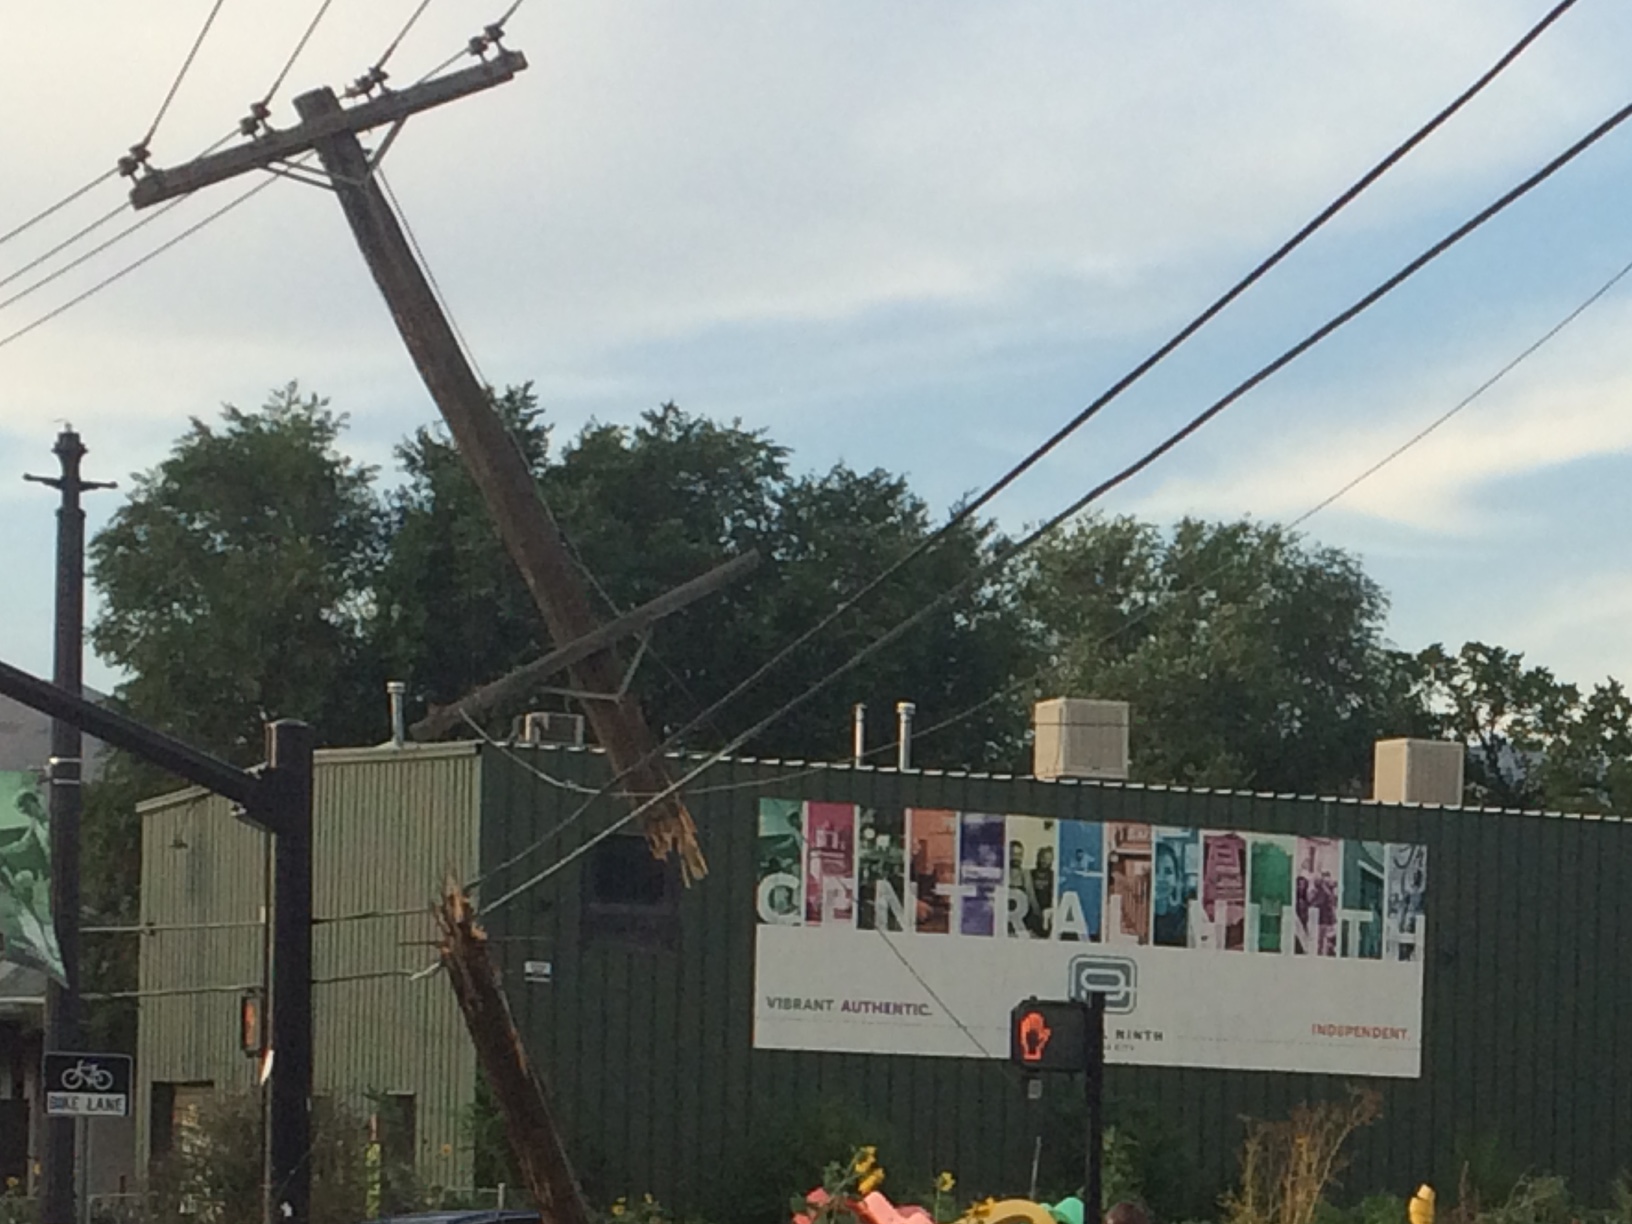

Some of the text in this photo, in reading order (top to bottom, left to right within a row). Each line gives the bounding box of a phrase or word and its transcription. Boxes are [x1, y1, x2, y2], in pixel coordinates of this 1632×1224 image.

[757, 872, 1426, 963] CENTRAL NINTH
[766, 996, 834, 1012] VIBRANT
[1116, 1029, 1163, 1041] NINTH
[49, 1096, 123, 1112] BIKE LANE
